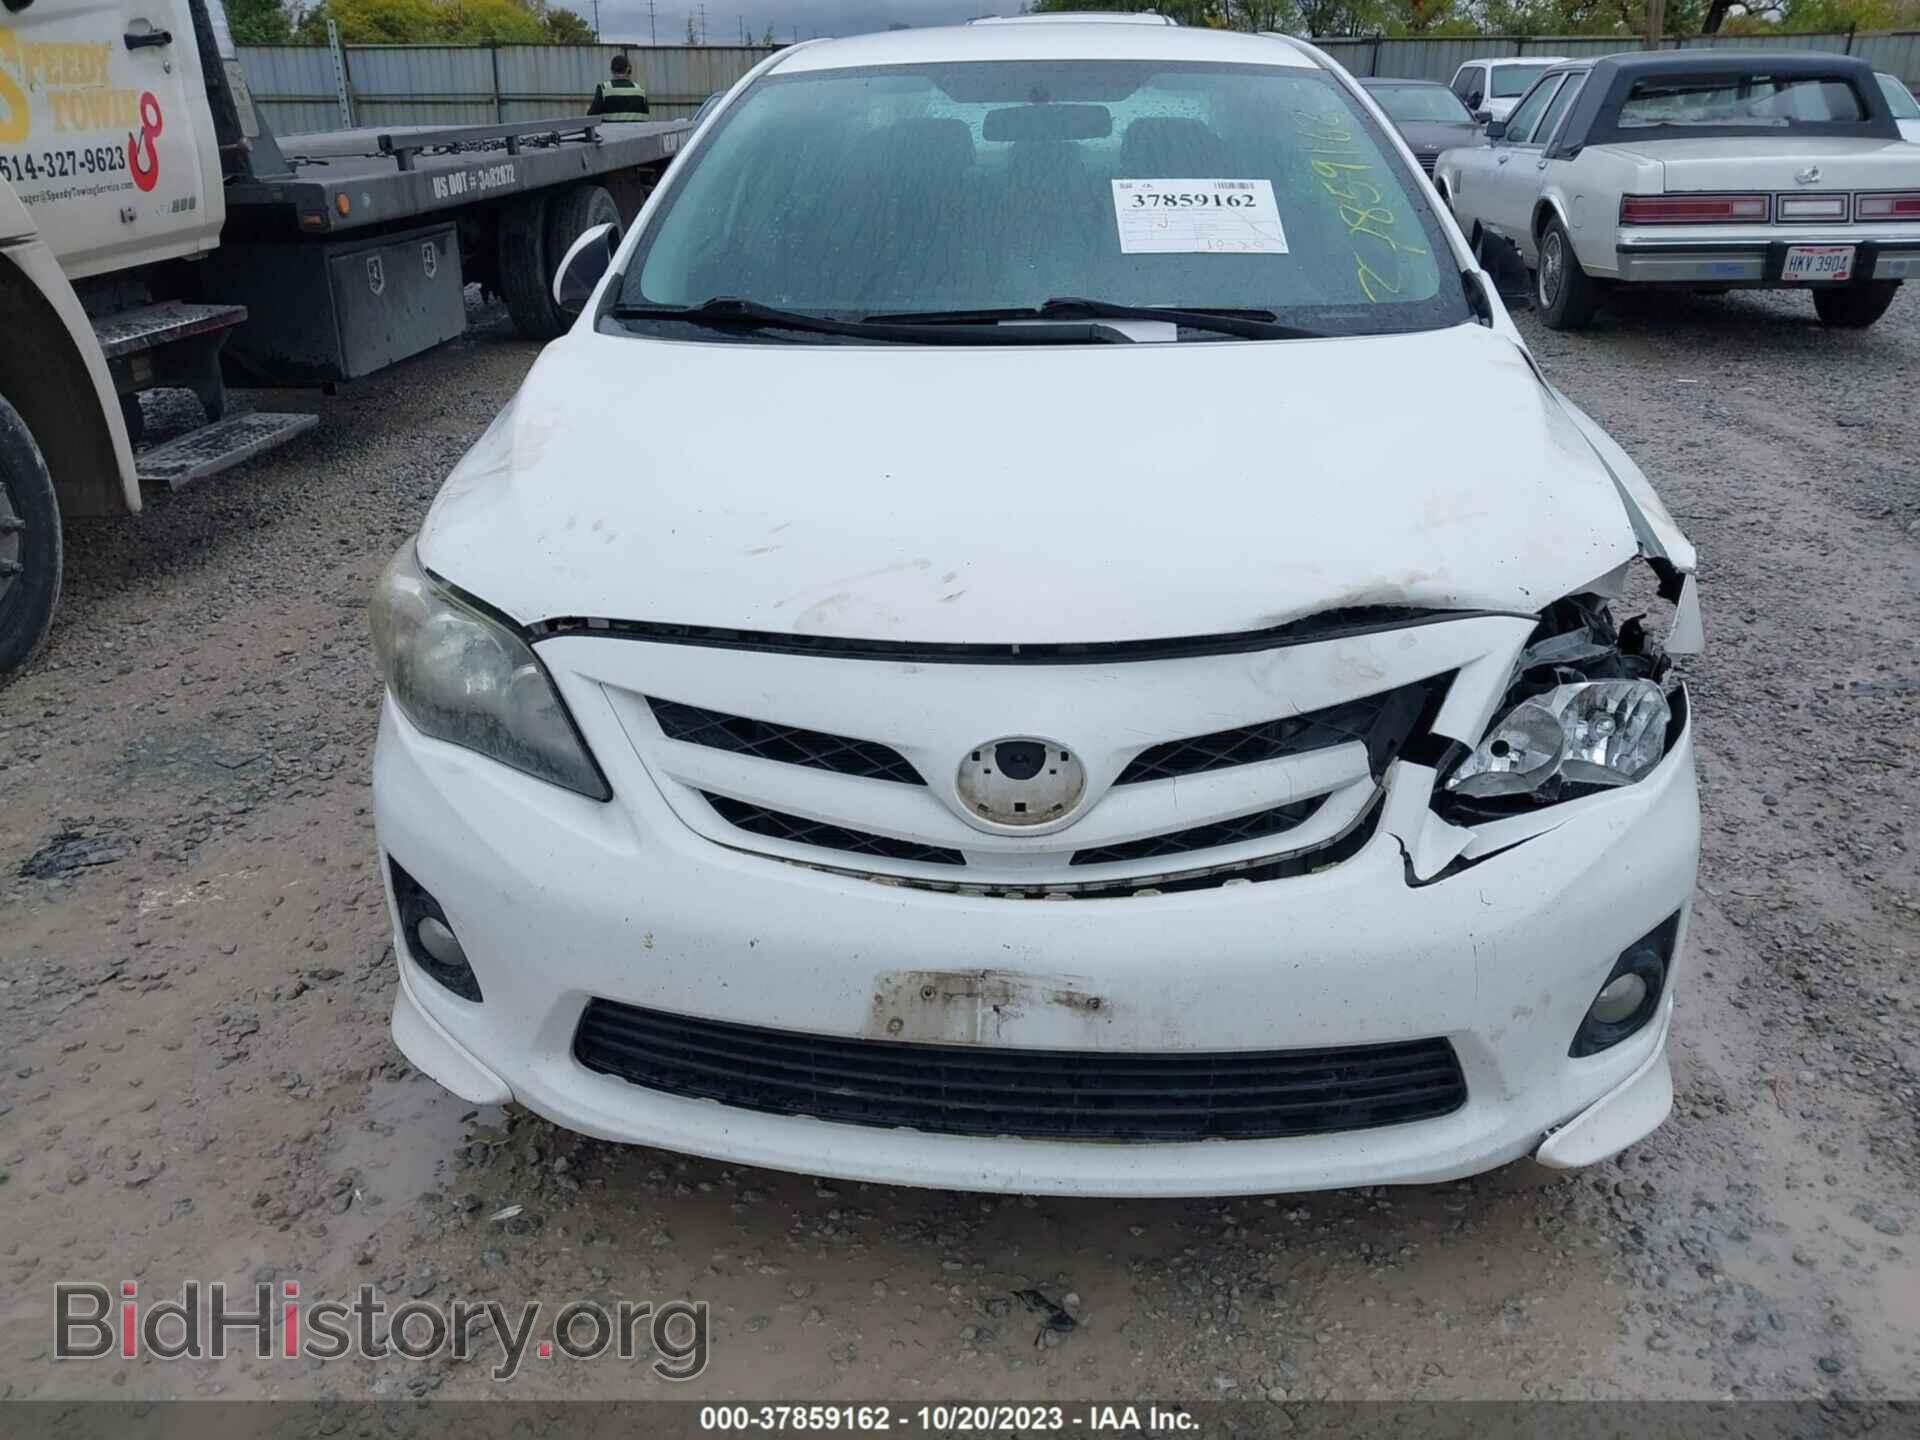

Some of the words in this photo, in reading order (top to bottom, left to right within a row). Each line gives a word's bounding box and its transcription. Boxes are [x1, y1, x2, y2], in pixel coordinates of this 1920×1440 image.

[0, 145, 125, 182] 614-327-9623
[433, 177, 448, 199] US
[448, 171, 467, 195] DOT
[1131, 193, 1256, 208] 37859162
